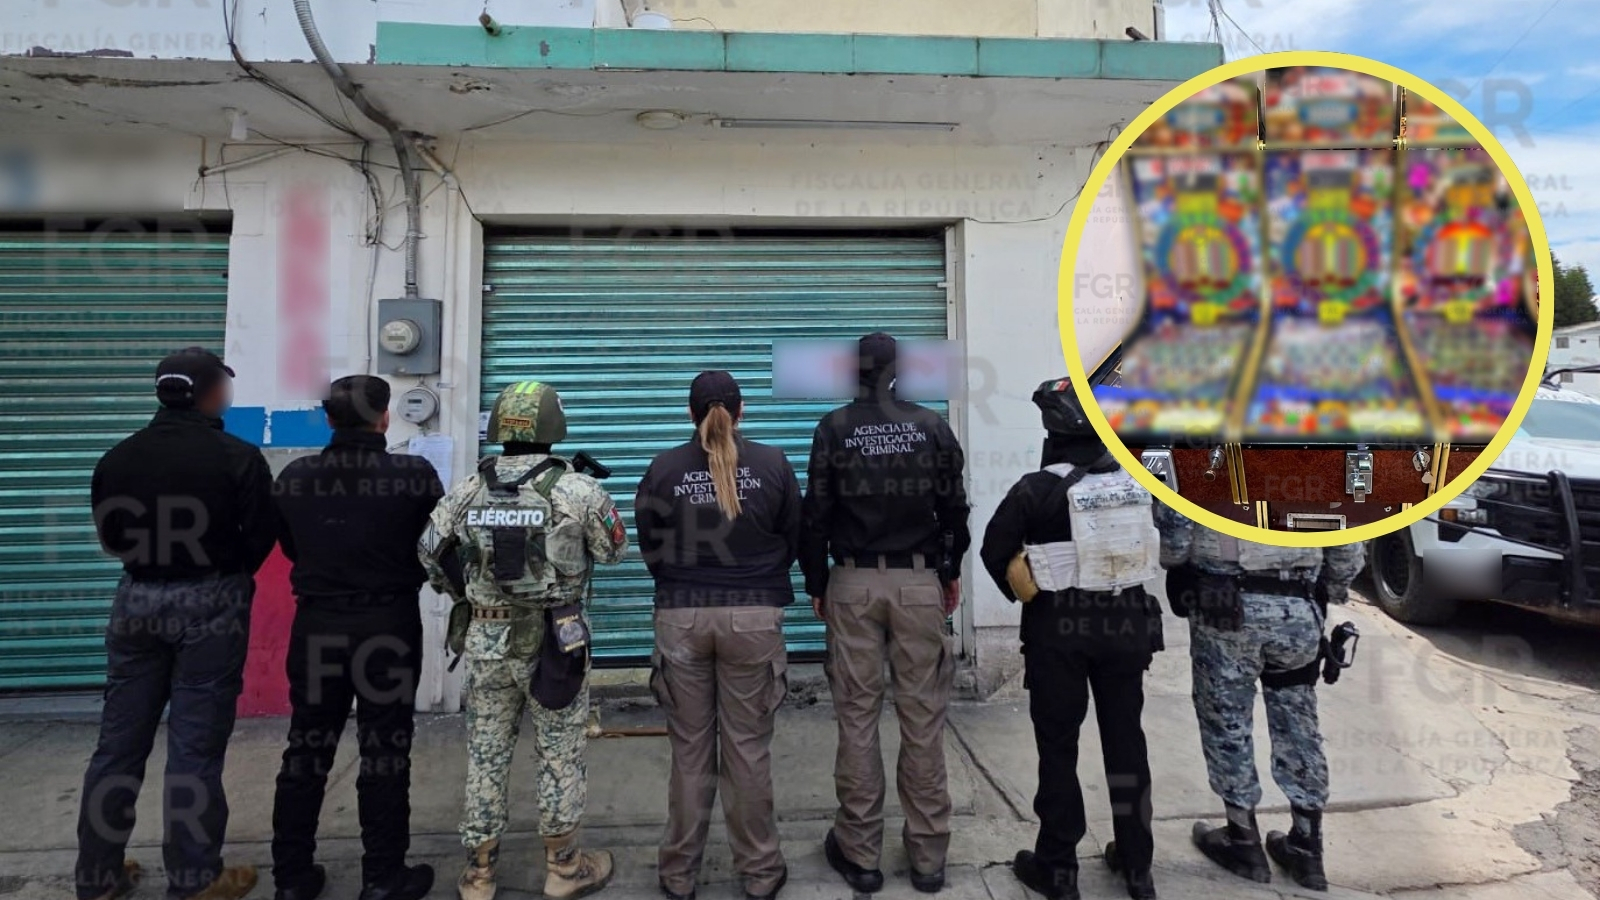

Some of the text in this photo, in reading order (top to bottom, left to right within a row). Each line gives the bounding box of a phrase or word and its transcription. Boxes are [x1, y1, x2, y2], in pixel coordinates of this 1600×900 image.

[853, 421, 917, 436] AGENCIA DE
[844, 431, 927, 448] INVESTIGACIÓN
[861, 442, 915, 456] CRIMINAL
[682, 467, 751, 484] AGEN DE
[467, 507, 545, 527] EJÉRCITO
